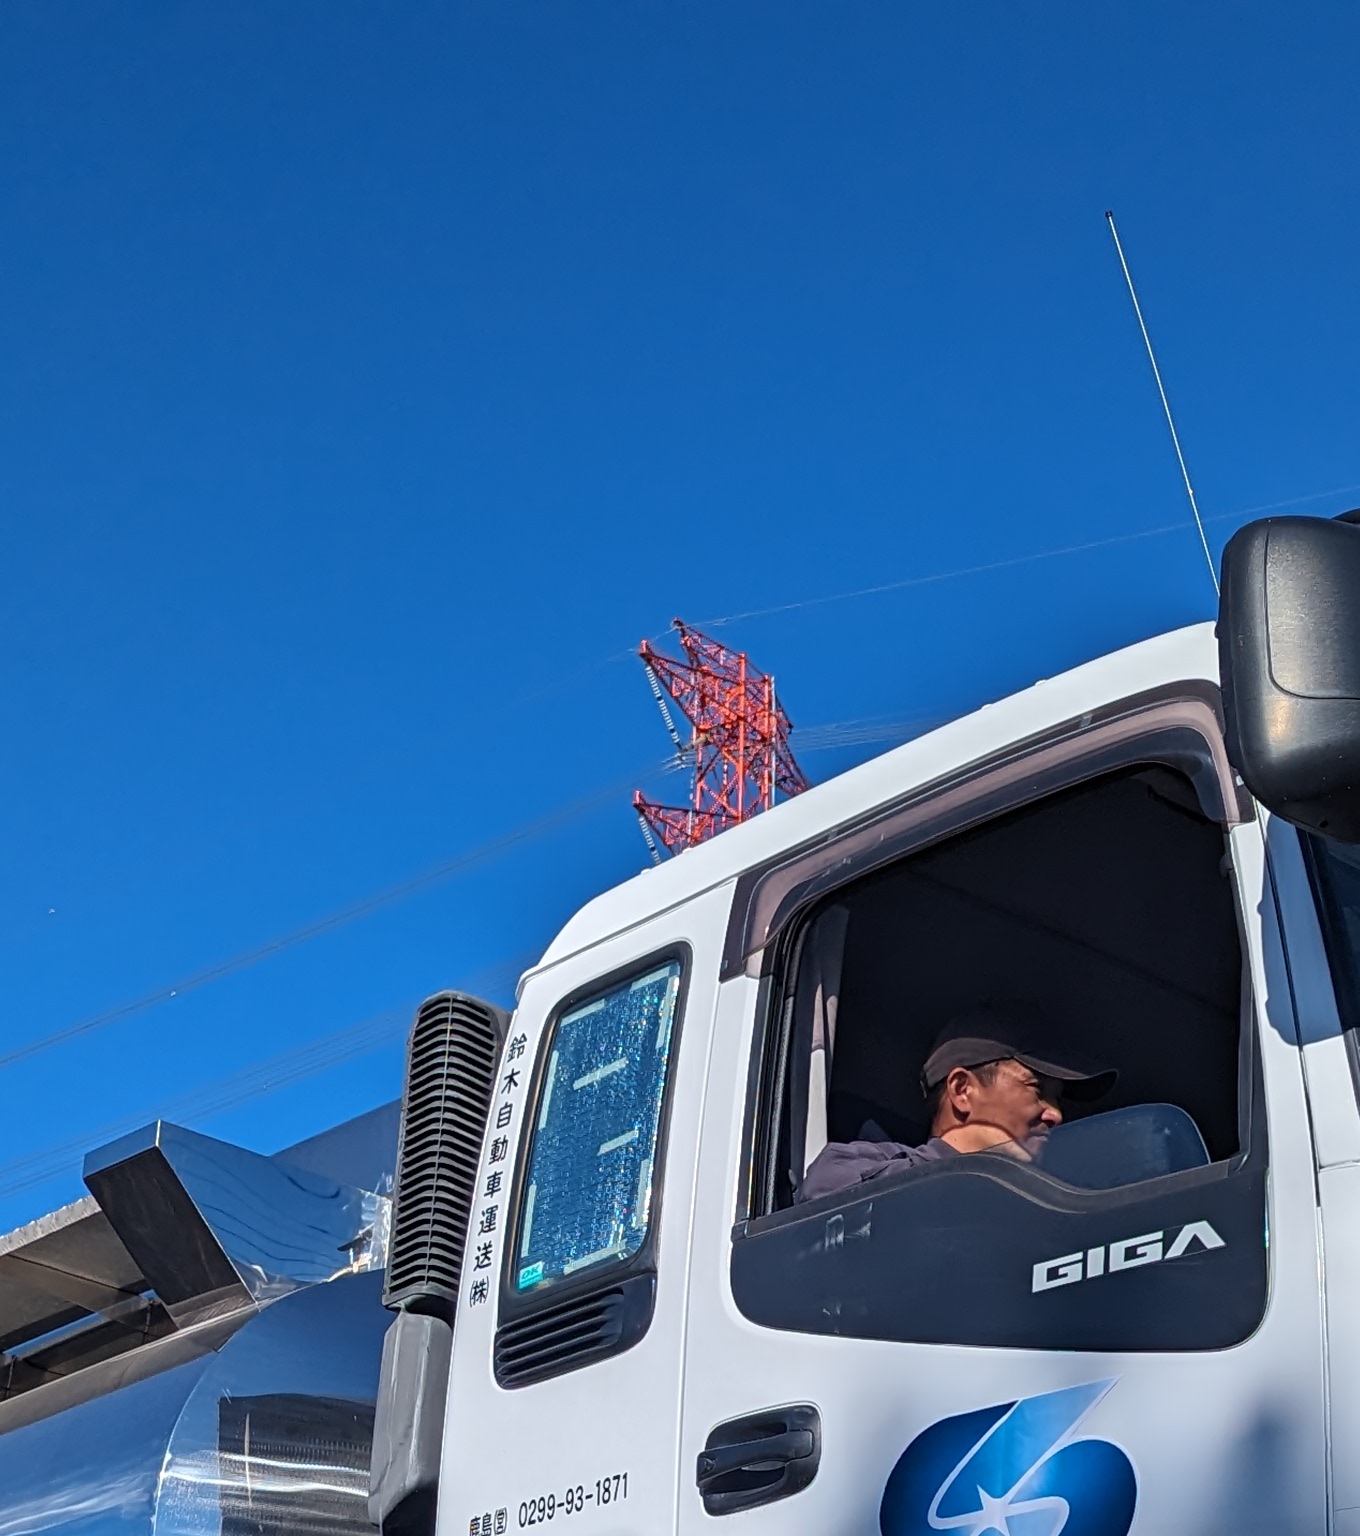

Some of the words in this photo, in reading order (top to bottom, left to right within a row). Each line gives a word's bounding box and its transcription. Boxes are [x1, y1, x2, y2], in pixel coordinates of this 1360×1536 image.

[522, 1264, 540, 1281] OK
[1031, 1220, 1227, 1294] GIGA
[518, 1472, 629, 1529] 0299-93-1871
